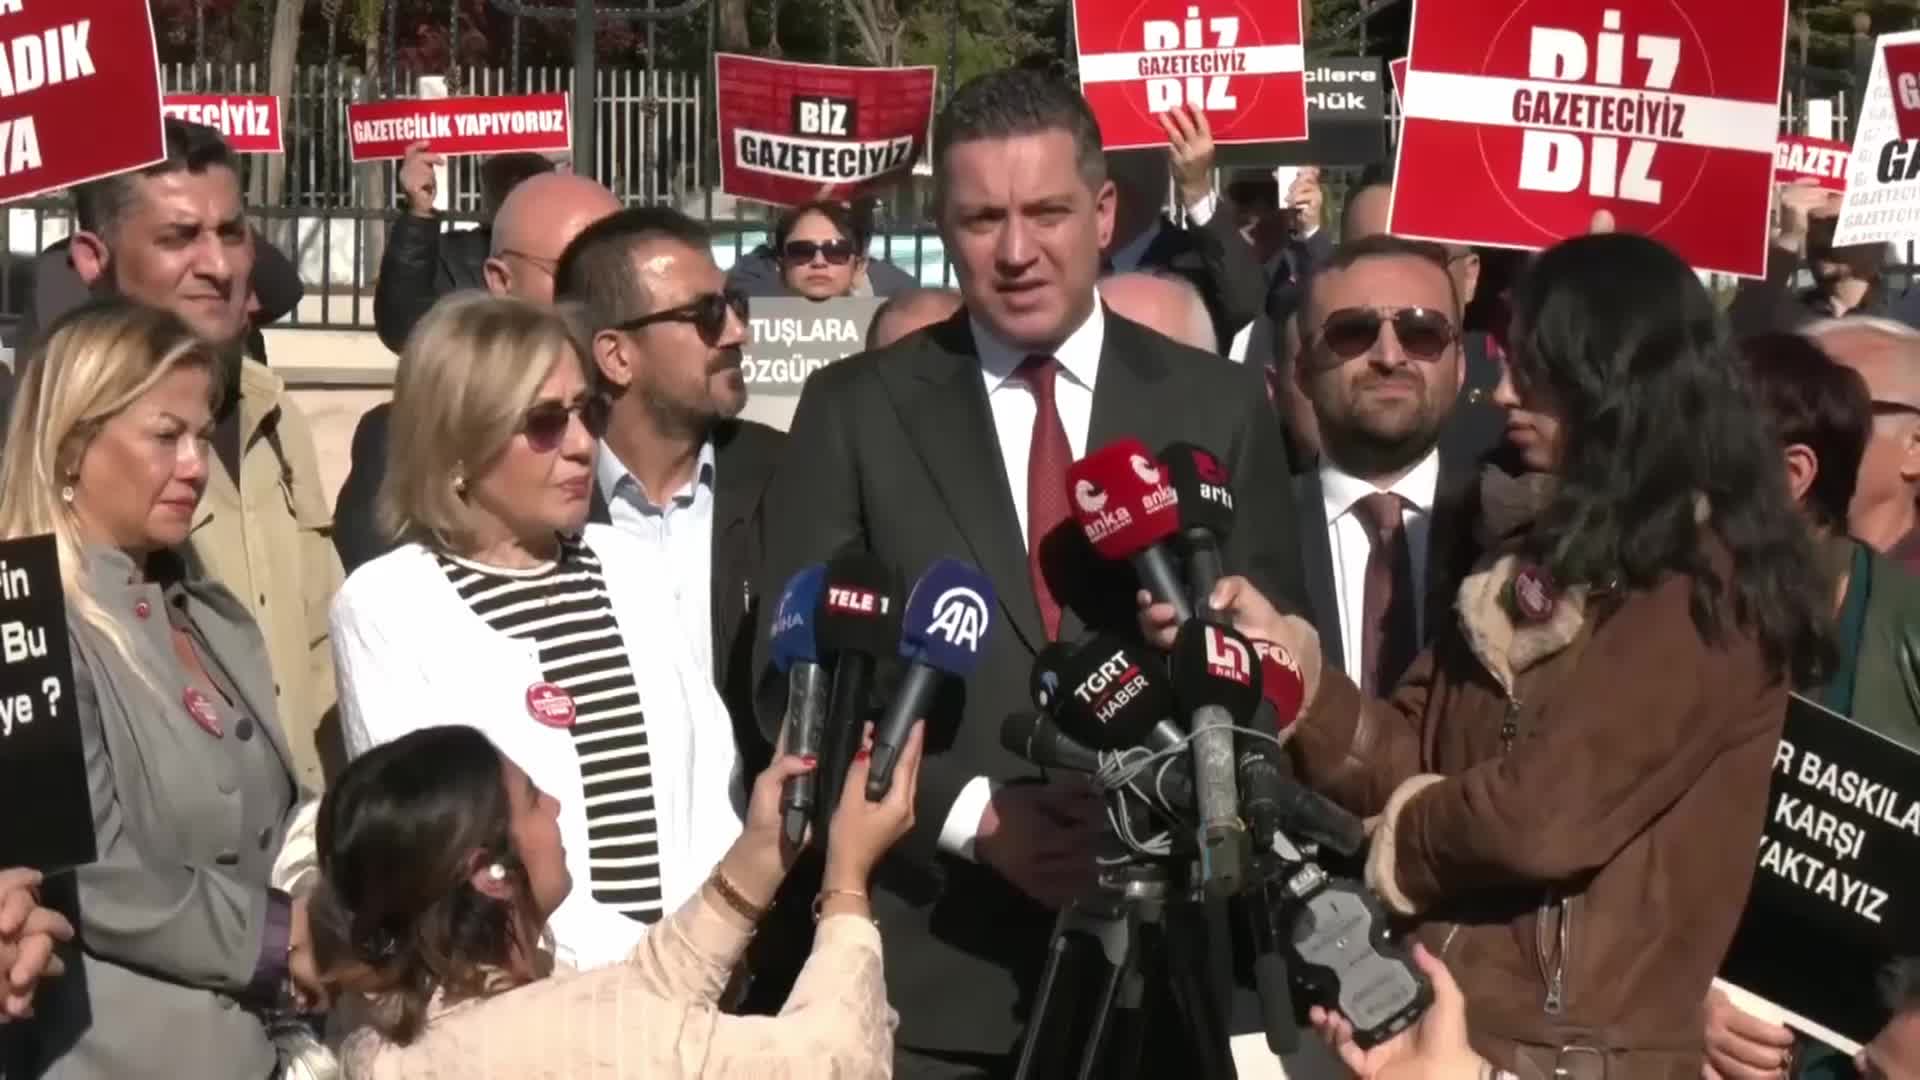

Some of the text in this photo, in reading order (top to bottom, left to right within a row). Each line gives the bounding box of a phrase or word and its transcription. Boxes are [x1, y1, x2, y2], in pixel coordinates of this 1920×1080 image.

[1138, 51, 1246, 76] GAZETECİYİZ
[353, 109, 564, 144] GAZETECİLİK YAPIYORUZ
[800, 97, 847, 136] BİZ
[1512, 88, 1686, 138] GAZETECİYİZ
[740, 135, 909, 178] GAZETECİYİZ
[750, 318, 859, 348] TUŞLARA
[829, 588, 874, 612] TELE
[1, 621, 47, 663] Bu
[42, 676, 61, 717] ?
[1074, 650, 1130, 702] TGRT
[1096, 675, 1150, 724] HABER
[1774, 792, 1866, 860] KARŞI
